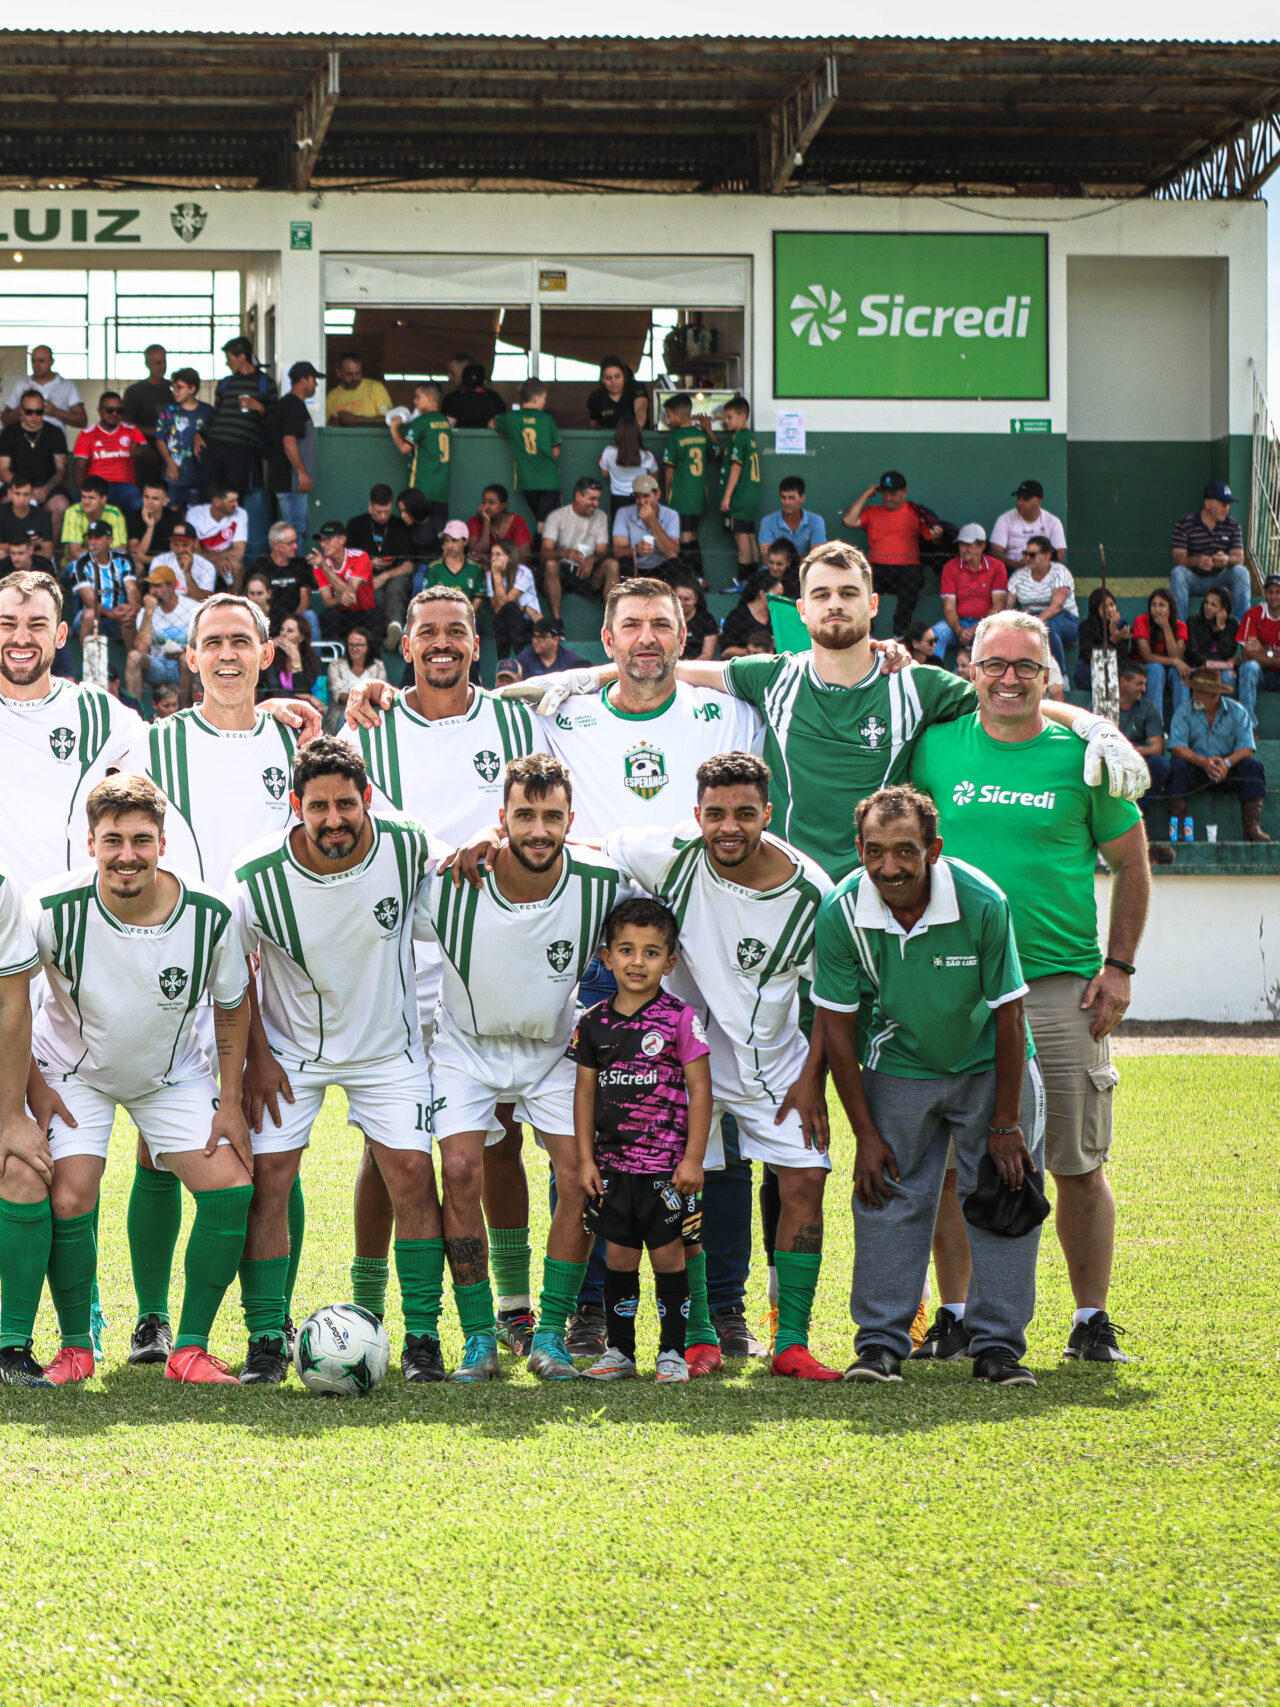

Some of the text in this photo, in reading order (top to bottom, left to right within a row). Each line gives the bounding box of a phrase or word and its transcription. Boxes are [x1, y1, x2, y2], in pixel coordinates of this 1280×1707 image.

[857, 294, 1031, 338] Sicredi
[438, 432, 450, 463] 9
[522, 428, 537, 455] 8
[689, 447, 703, 477] 3
[978, 785, 1056, 809] Sicredi
[609, 1069, 657, 1085] Sicredi
[414, 1103, 433, 1134] 18
